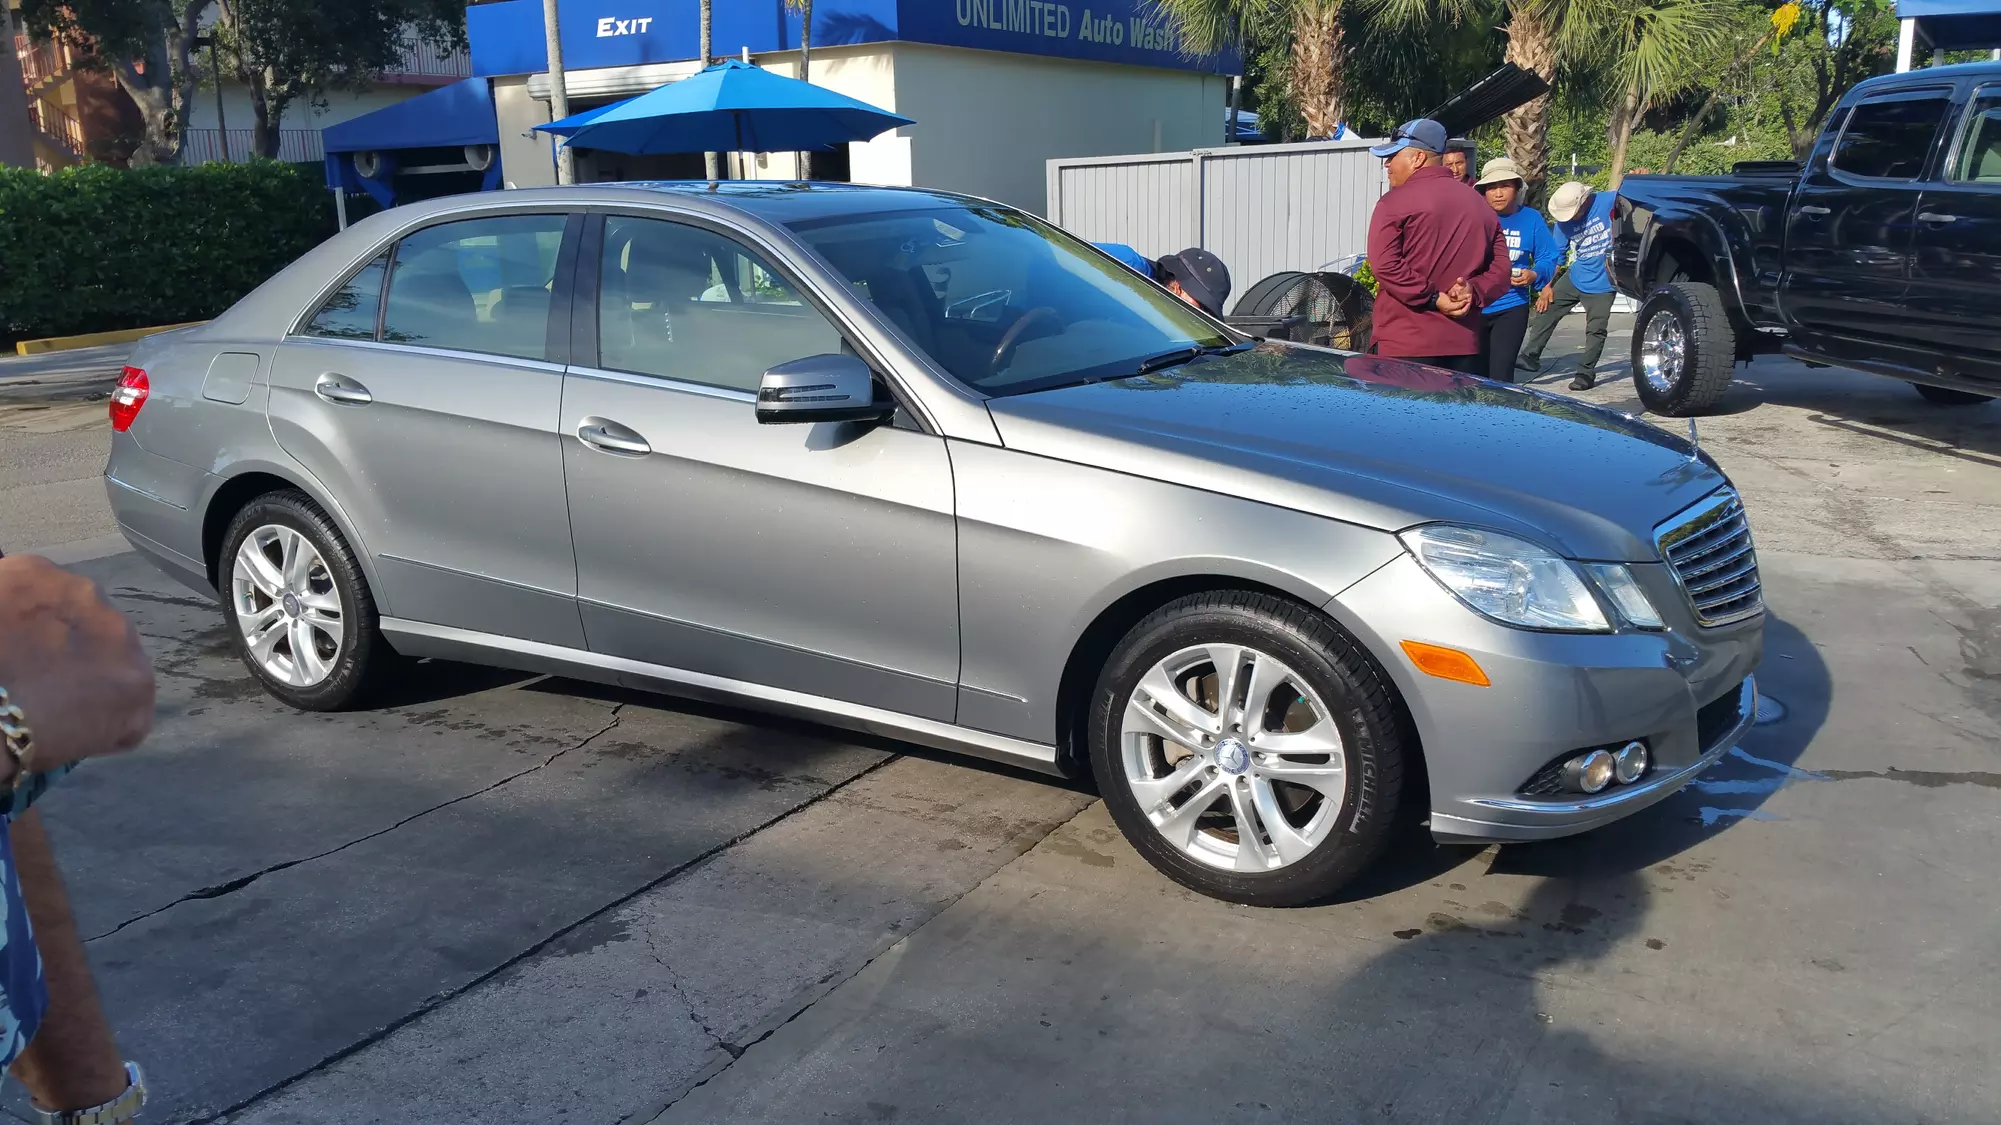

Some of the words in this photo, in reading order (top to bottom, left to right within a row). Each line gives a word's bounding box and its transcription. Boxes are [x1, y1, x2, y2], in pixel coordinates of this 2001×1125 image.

[955, 0, 1070, 39] UNLIMITED
[1078, 8, 1124, 46] Auto
[1130, 17, 1173, 52] Wash
